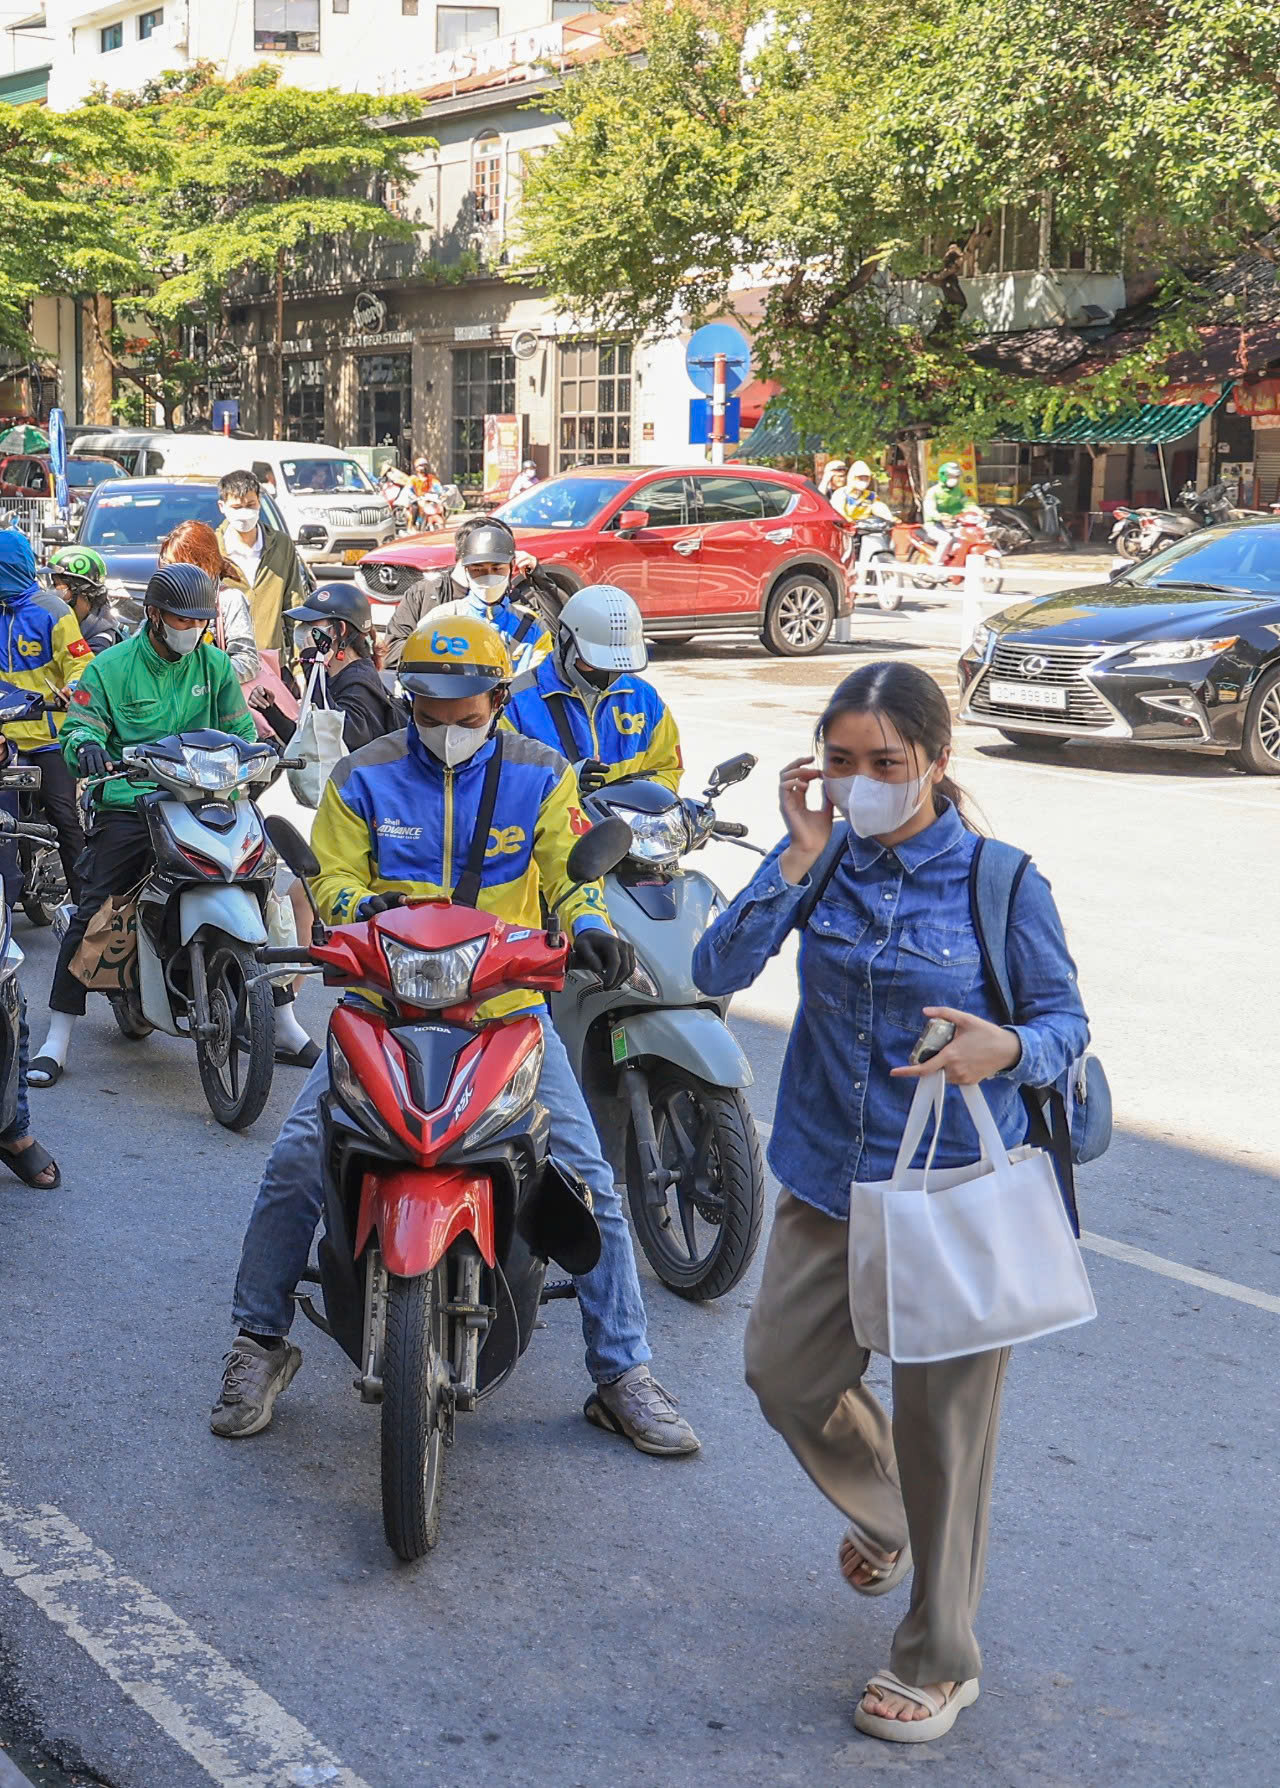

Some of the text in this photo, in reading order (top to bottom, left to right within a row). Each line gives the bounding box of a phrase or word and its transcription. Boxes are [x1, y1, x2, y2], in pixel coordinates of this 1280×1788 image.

[18, 634, 42, 656] be
[431, 631, 470, 656] be
[612, 706, 645, 735] be
[377, 824, 424, 836] ADVANCE
[384, 817, 400, 826] Shell
[414, 1026, 452, 1034] HONDA
